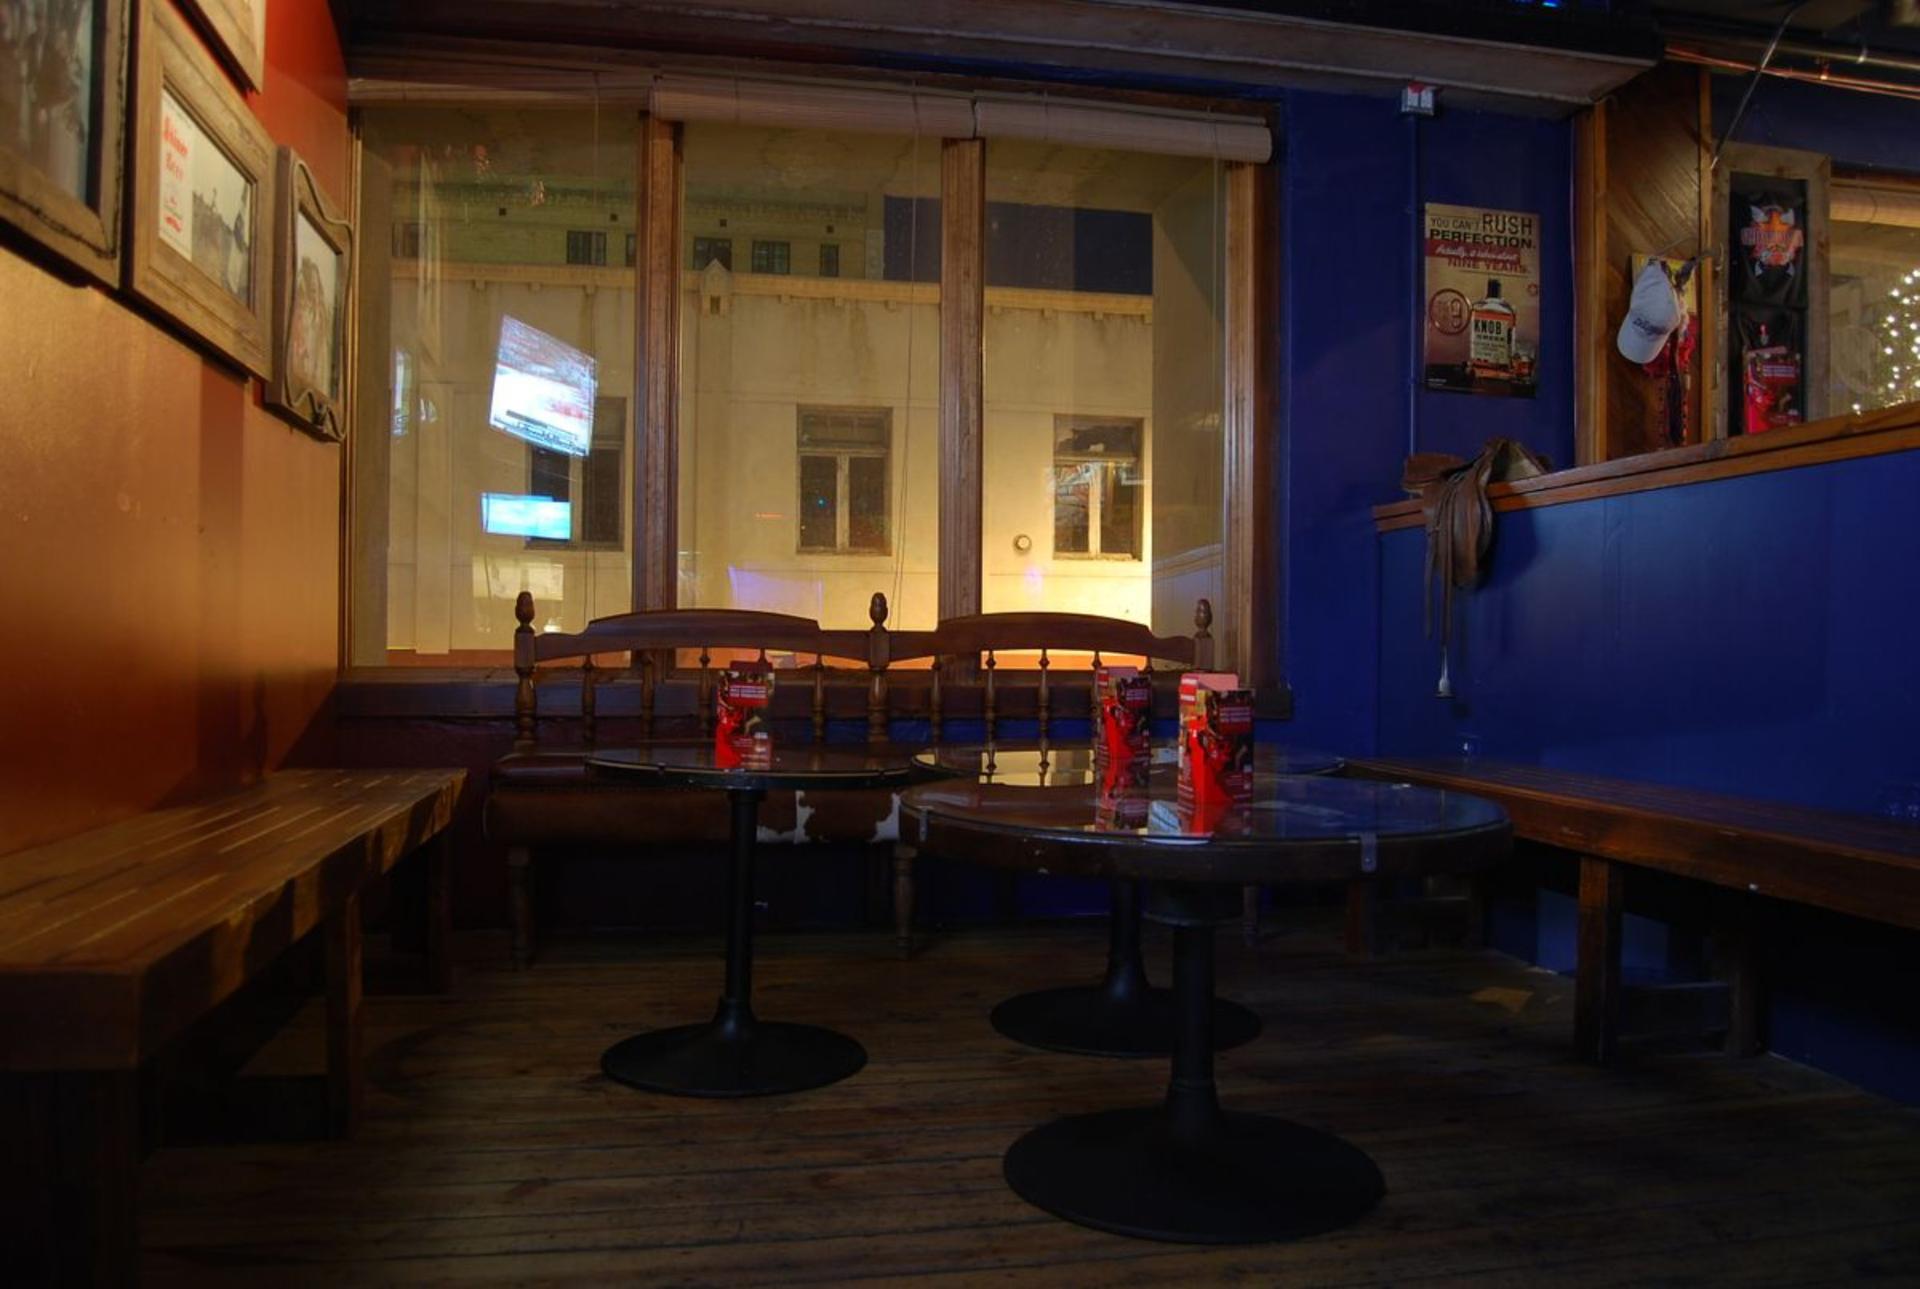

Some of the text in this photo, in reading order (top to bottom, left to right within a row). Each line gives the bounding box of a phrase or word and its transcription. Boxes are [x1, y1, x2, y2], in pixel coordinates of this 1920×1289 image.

[1431, 217, 1449, 228] YOU
[1482, 213, 1532, 235] RUSH
[1447, 256, 1480, 269] NINE
[1474, 319, 1502, 335] KNOB
